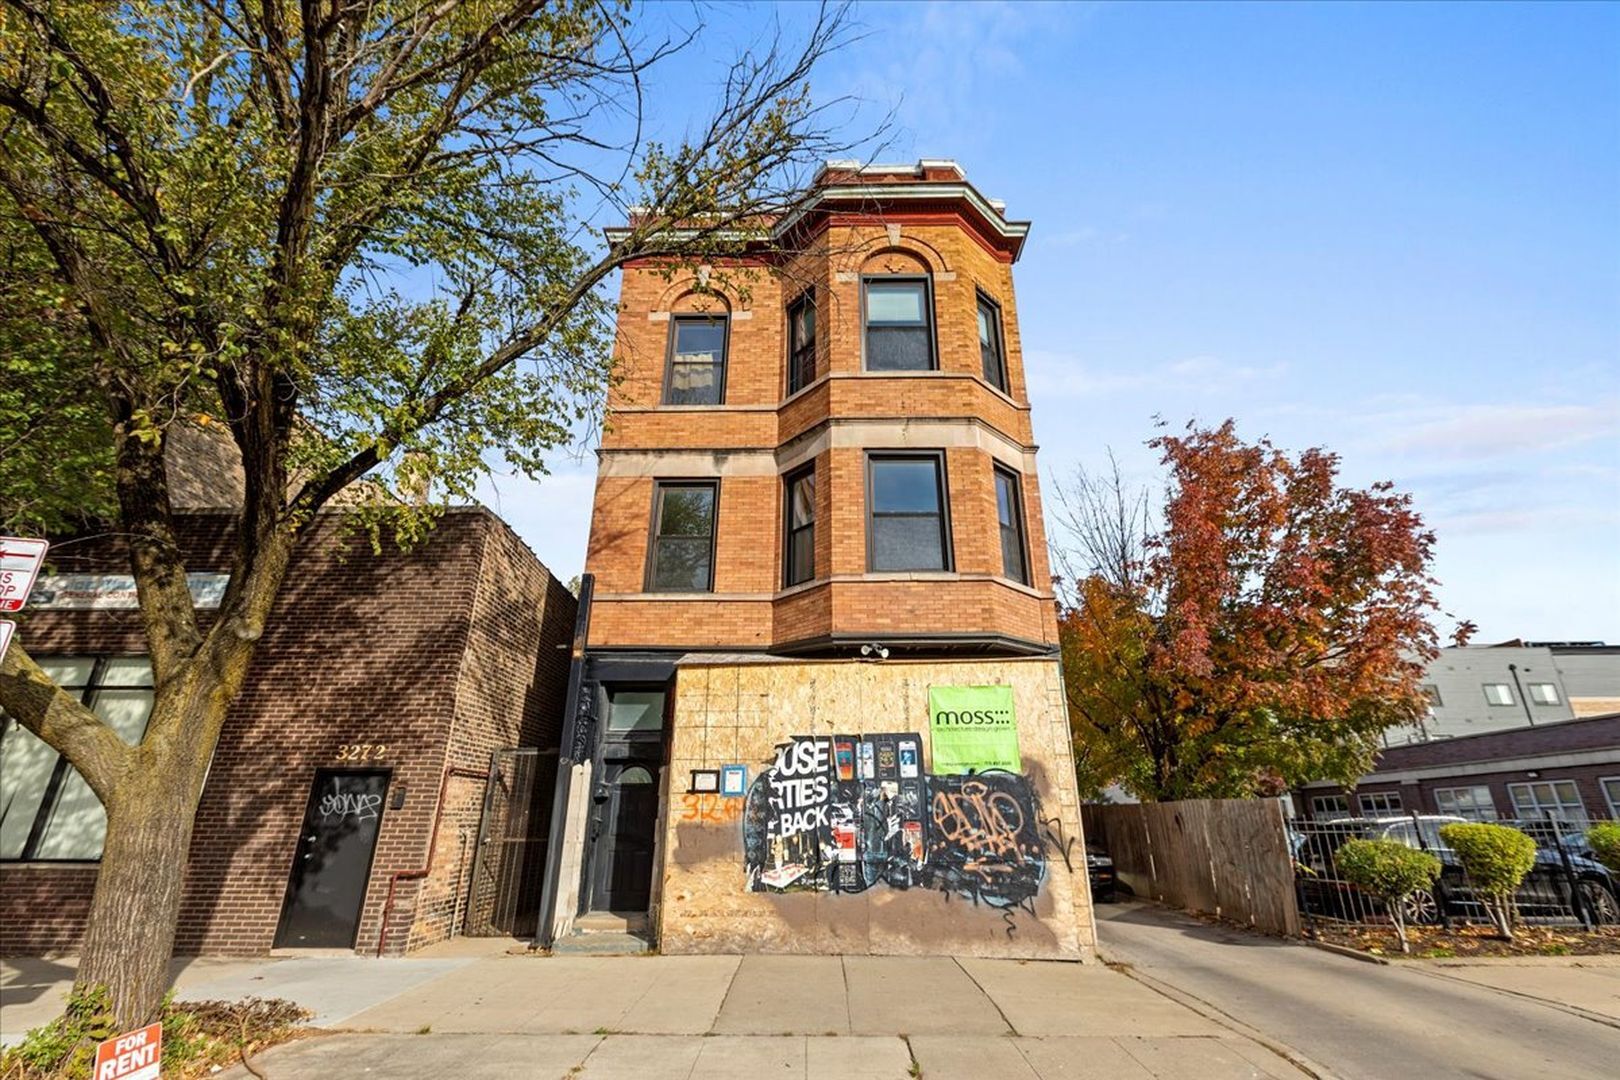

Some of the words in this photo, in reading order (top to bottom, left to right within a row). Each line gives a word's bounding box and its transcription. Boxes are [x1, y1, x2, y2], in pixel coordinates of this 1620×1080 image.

[335, 744, 386, 761] 3272
[780, 804, 830, 838] BACK
[114, 1031, 148, 1056] FOR
[99, 1042, 158, 1080] RENT
